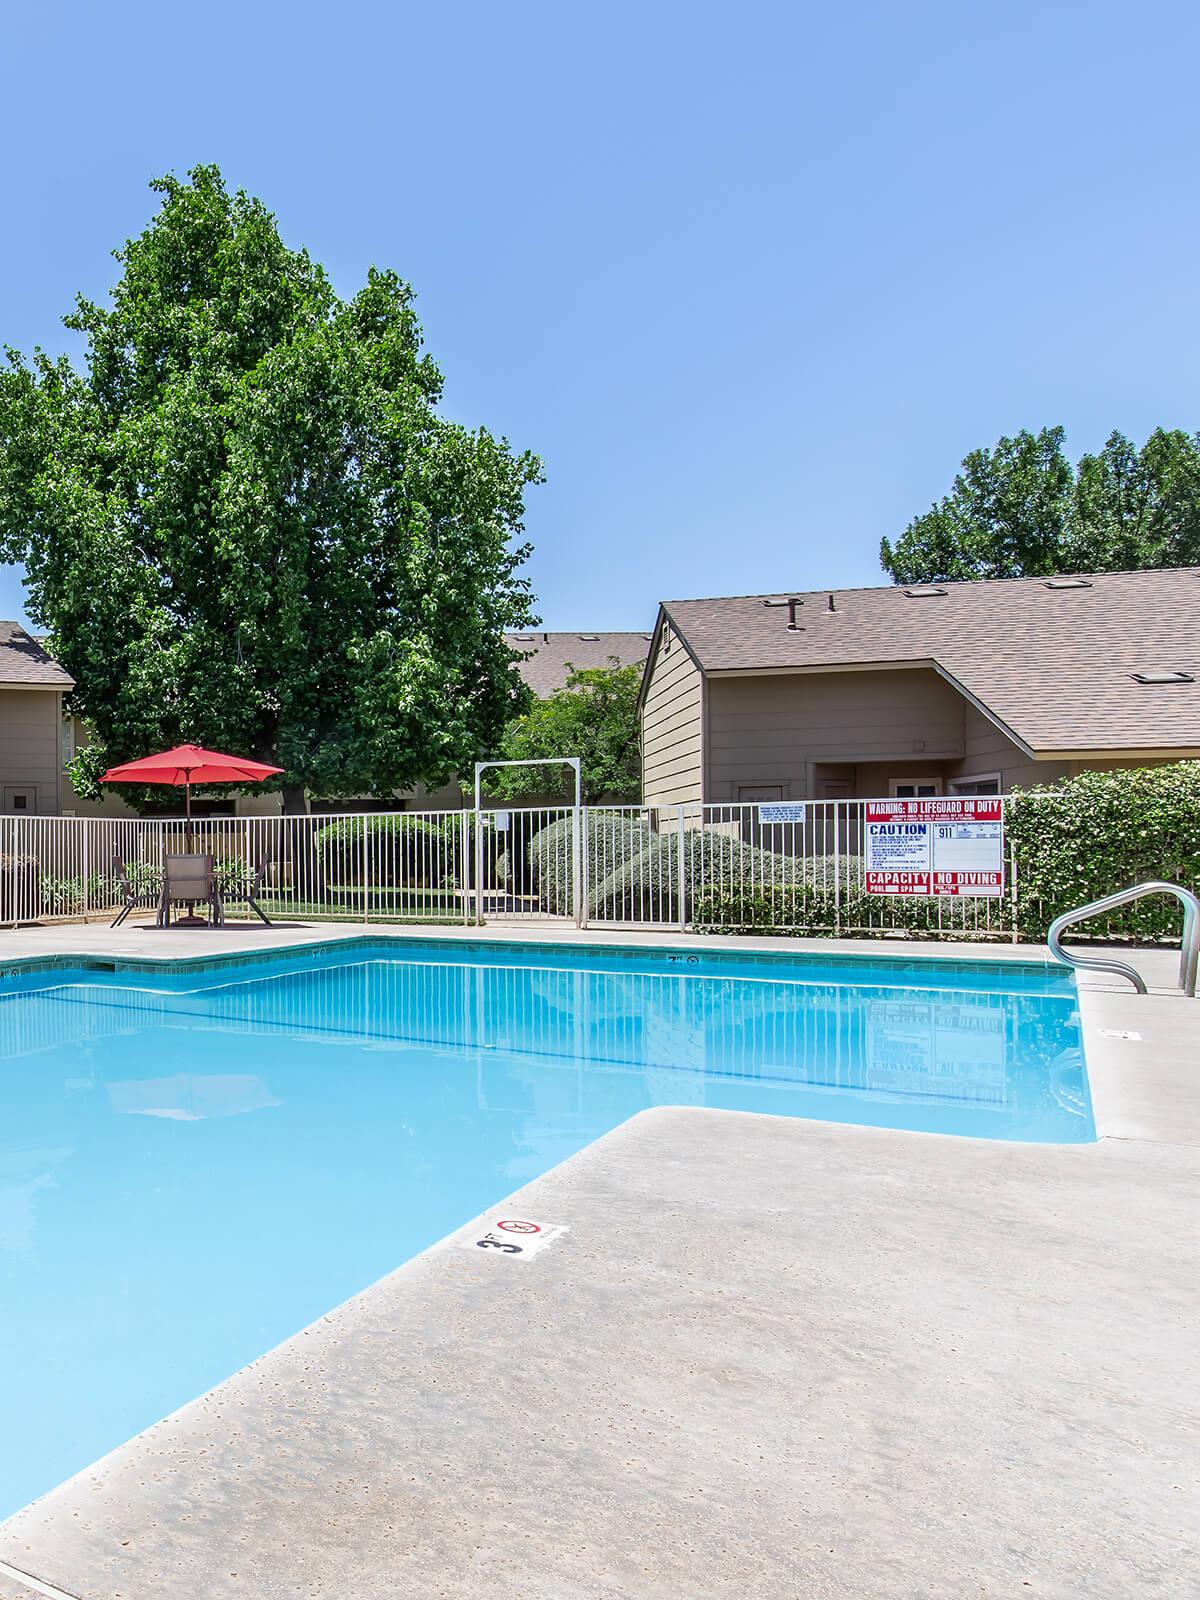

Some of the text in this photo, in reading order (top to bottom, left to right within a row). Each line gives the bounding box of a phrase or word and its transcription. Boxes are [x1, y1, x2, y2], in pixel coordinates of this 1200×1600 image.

[869, 800, 999, 815] WARNING: NO LIFEGUARD ON DUTY
[870, 824, 927, 835] CAUTION
[939, 828, 952, 838] 911
[869, 872, 928, 884] CAPACITY
[938, 873, 997, 884] NO DIVING
[476, 1240, 523, 1254] 3
